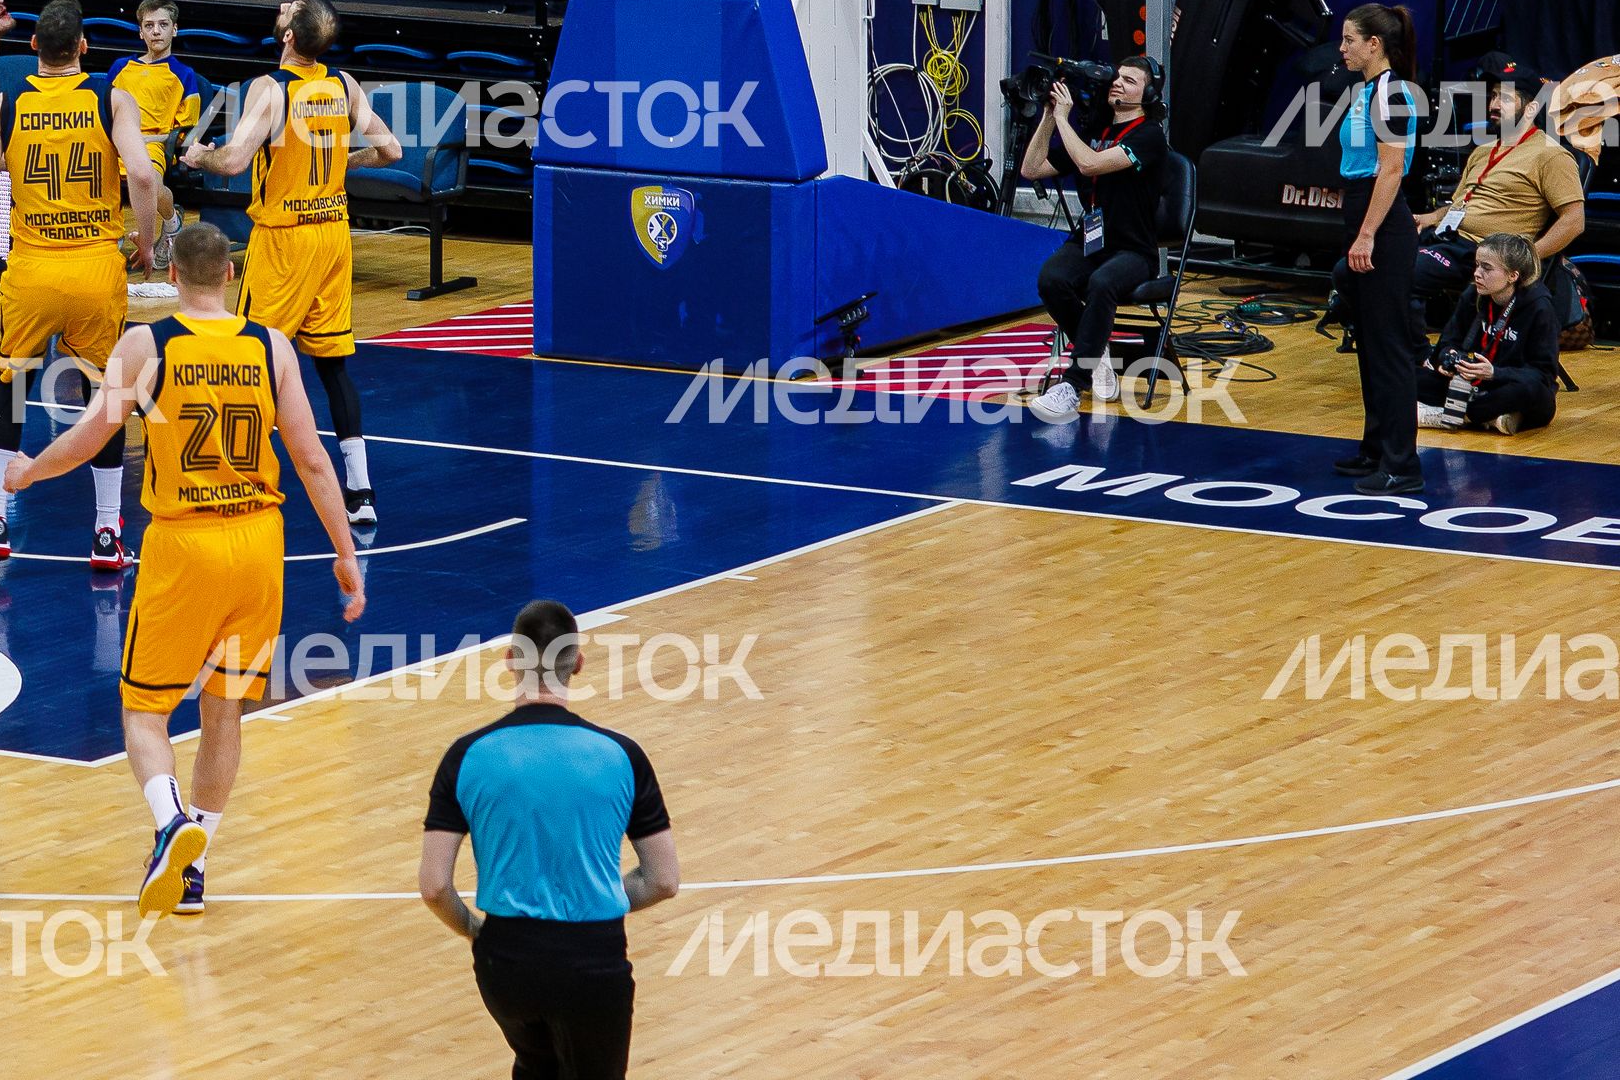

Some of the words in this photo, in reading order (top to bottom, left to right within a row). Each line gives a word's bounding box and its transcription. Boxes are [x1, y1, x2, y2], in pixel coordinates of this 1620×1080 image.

[20, 110, 95, 131] СОРОКИН
[23, 141, 102, 200] 44
[644, 195, 681, 208] ХИМКИ
[24, 209, 111, 226] МОСКОВСКАЯ
[173, 363, 262, 387] КОРШАКОВ
[178, 402, 263, 473] 20
